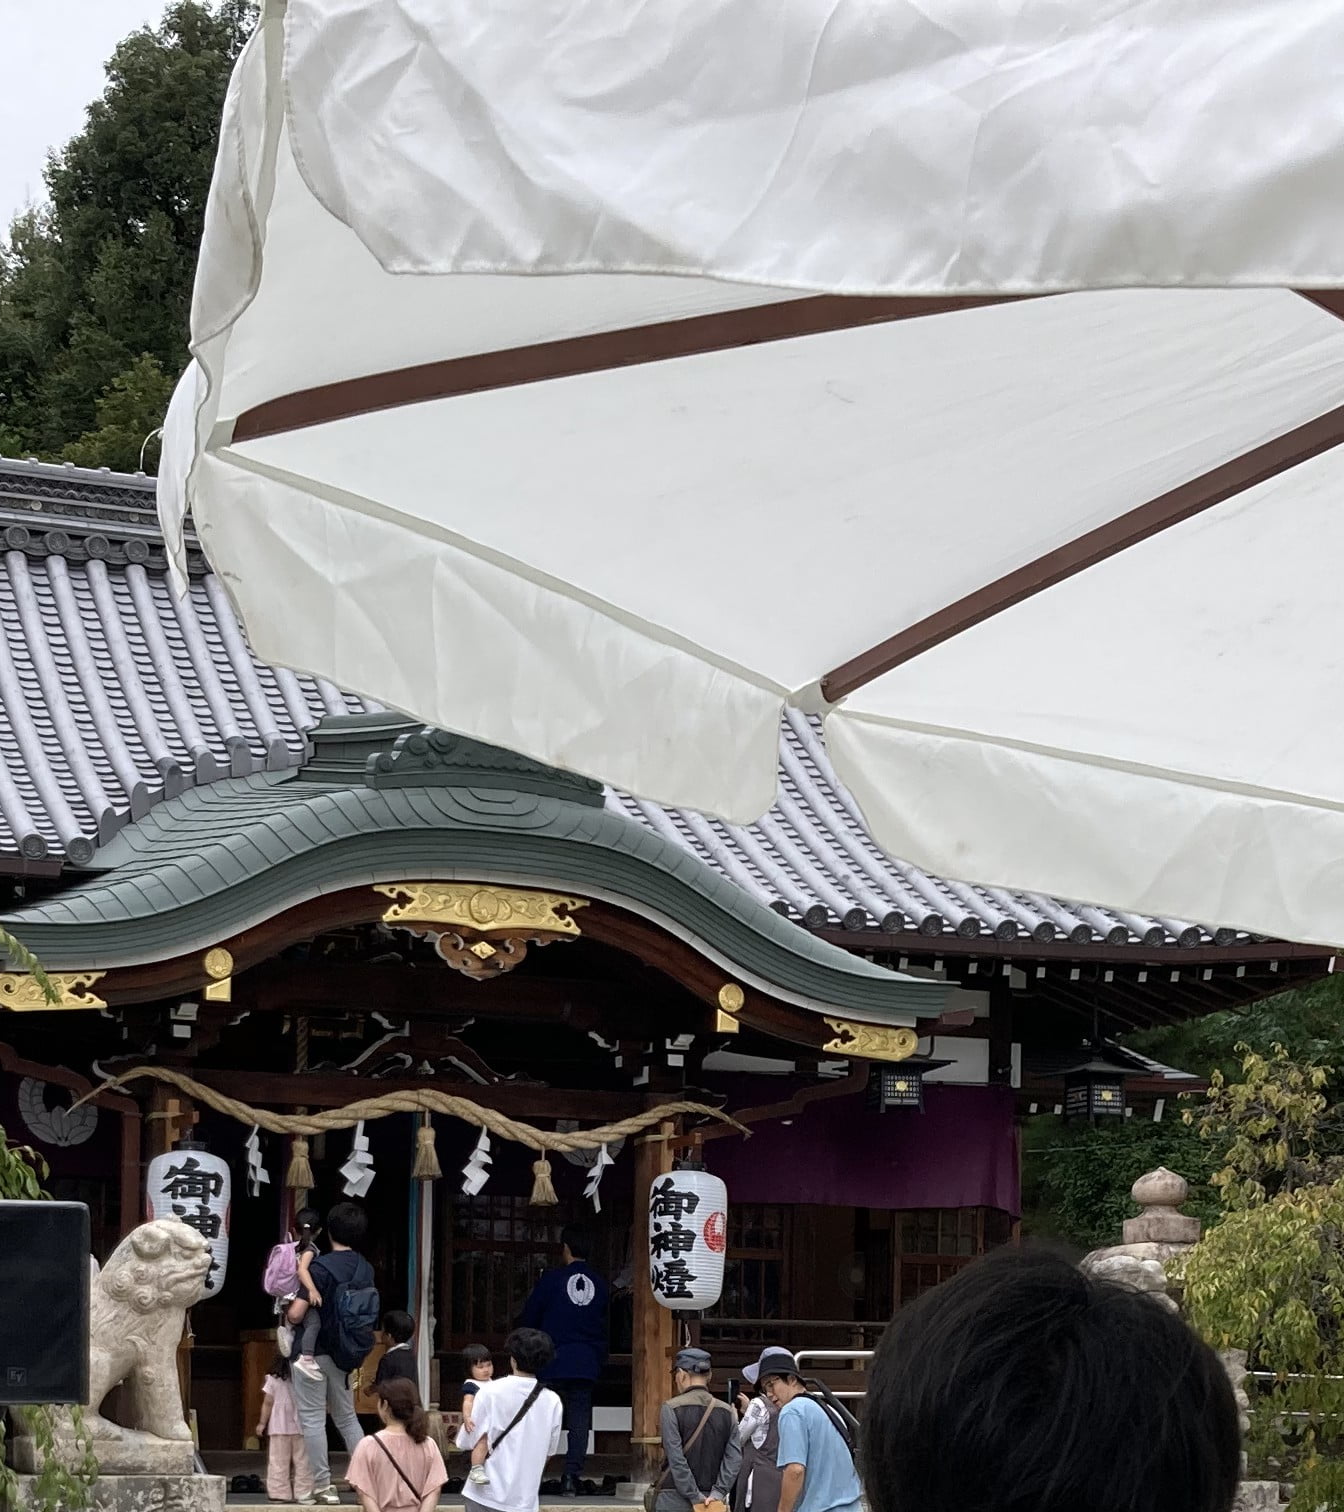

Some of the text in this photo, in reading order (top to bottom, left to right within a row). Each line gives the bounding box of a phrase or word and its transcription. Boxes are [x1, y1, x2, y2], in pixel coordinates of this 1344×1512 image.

[160, 1157, 224, 1290] 御神
[650, 1177, 699, 1298] 御神燈
